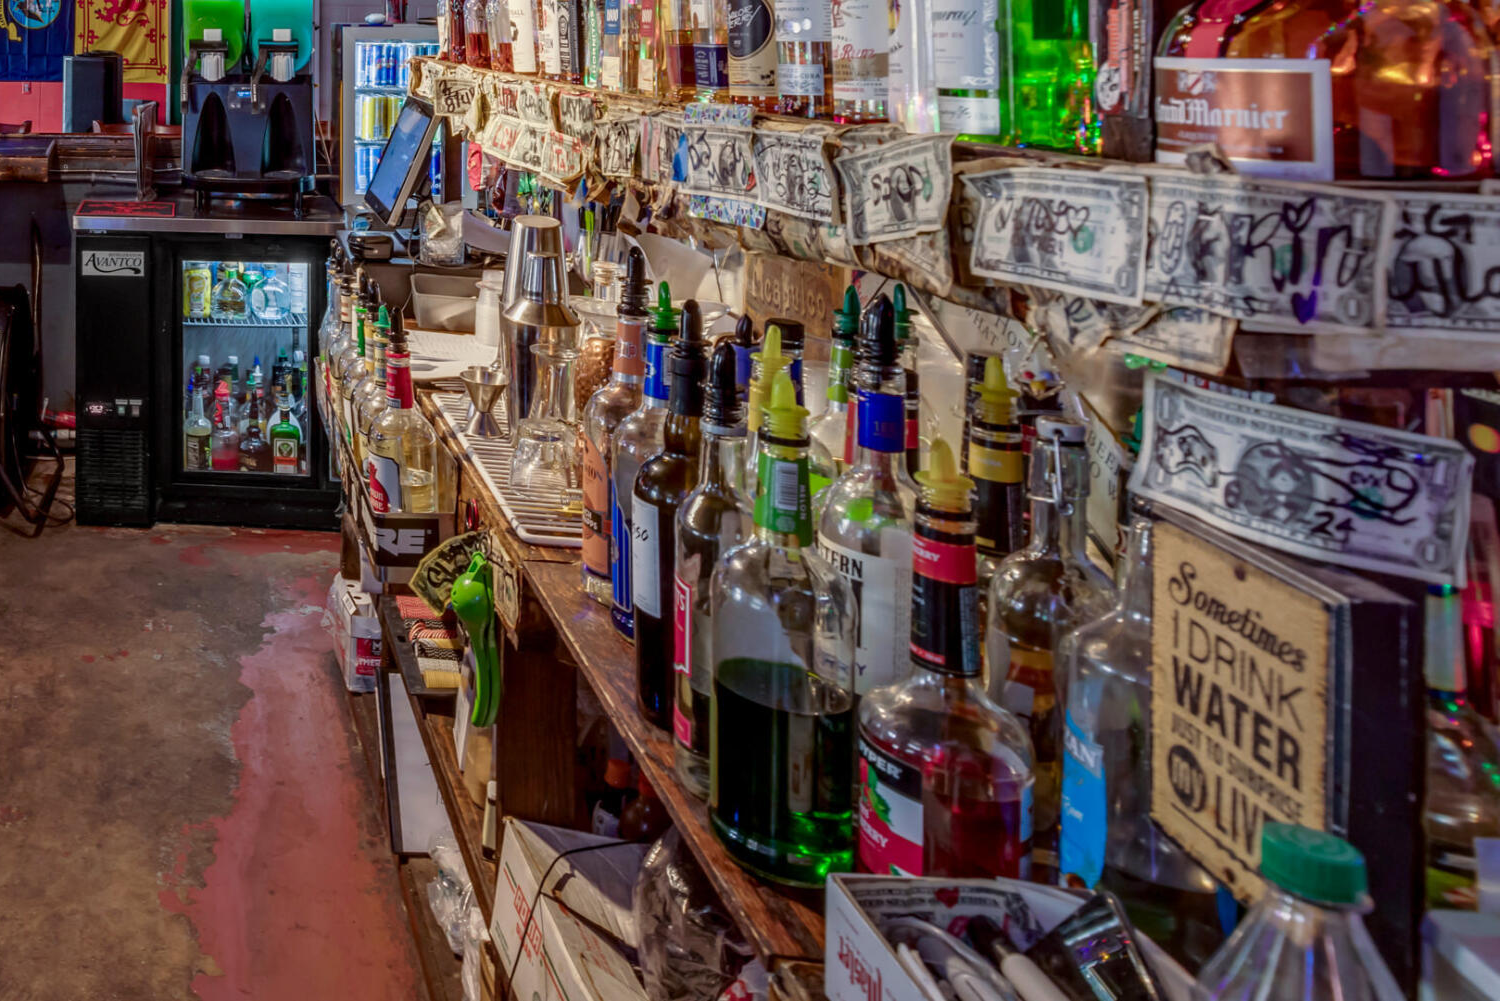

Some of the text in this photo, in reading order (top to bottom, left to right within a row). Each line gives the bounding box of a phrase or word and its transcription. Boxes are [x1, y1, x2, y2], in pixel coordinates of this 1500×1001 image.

[1186, 98, 1288, 130] Marnier
[84, 252, 143, 269] AVANTCO
[820, 543, 863, 579] TERN
[1167, 561, 1308, 673] Sometimes
[1187, 619, 1304, 733] DRINK
[860, 741, 902, 780] YPER
[1171, 655, 1303, 793] WATER
[1170, 712, 1305, 824] JUST TO SURPRISE
[1214, 776, 1261, 856] LIV
